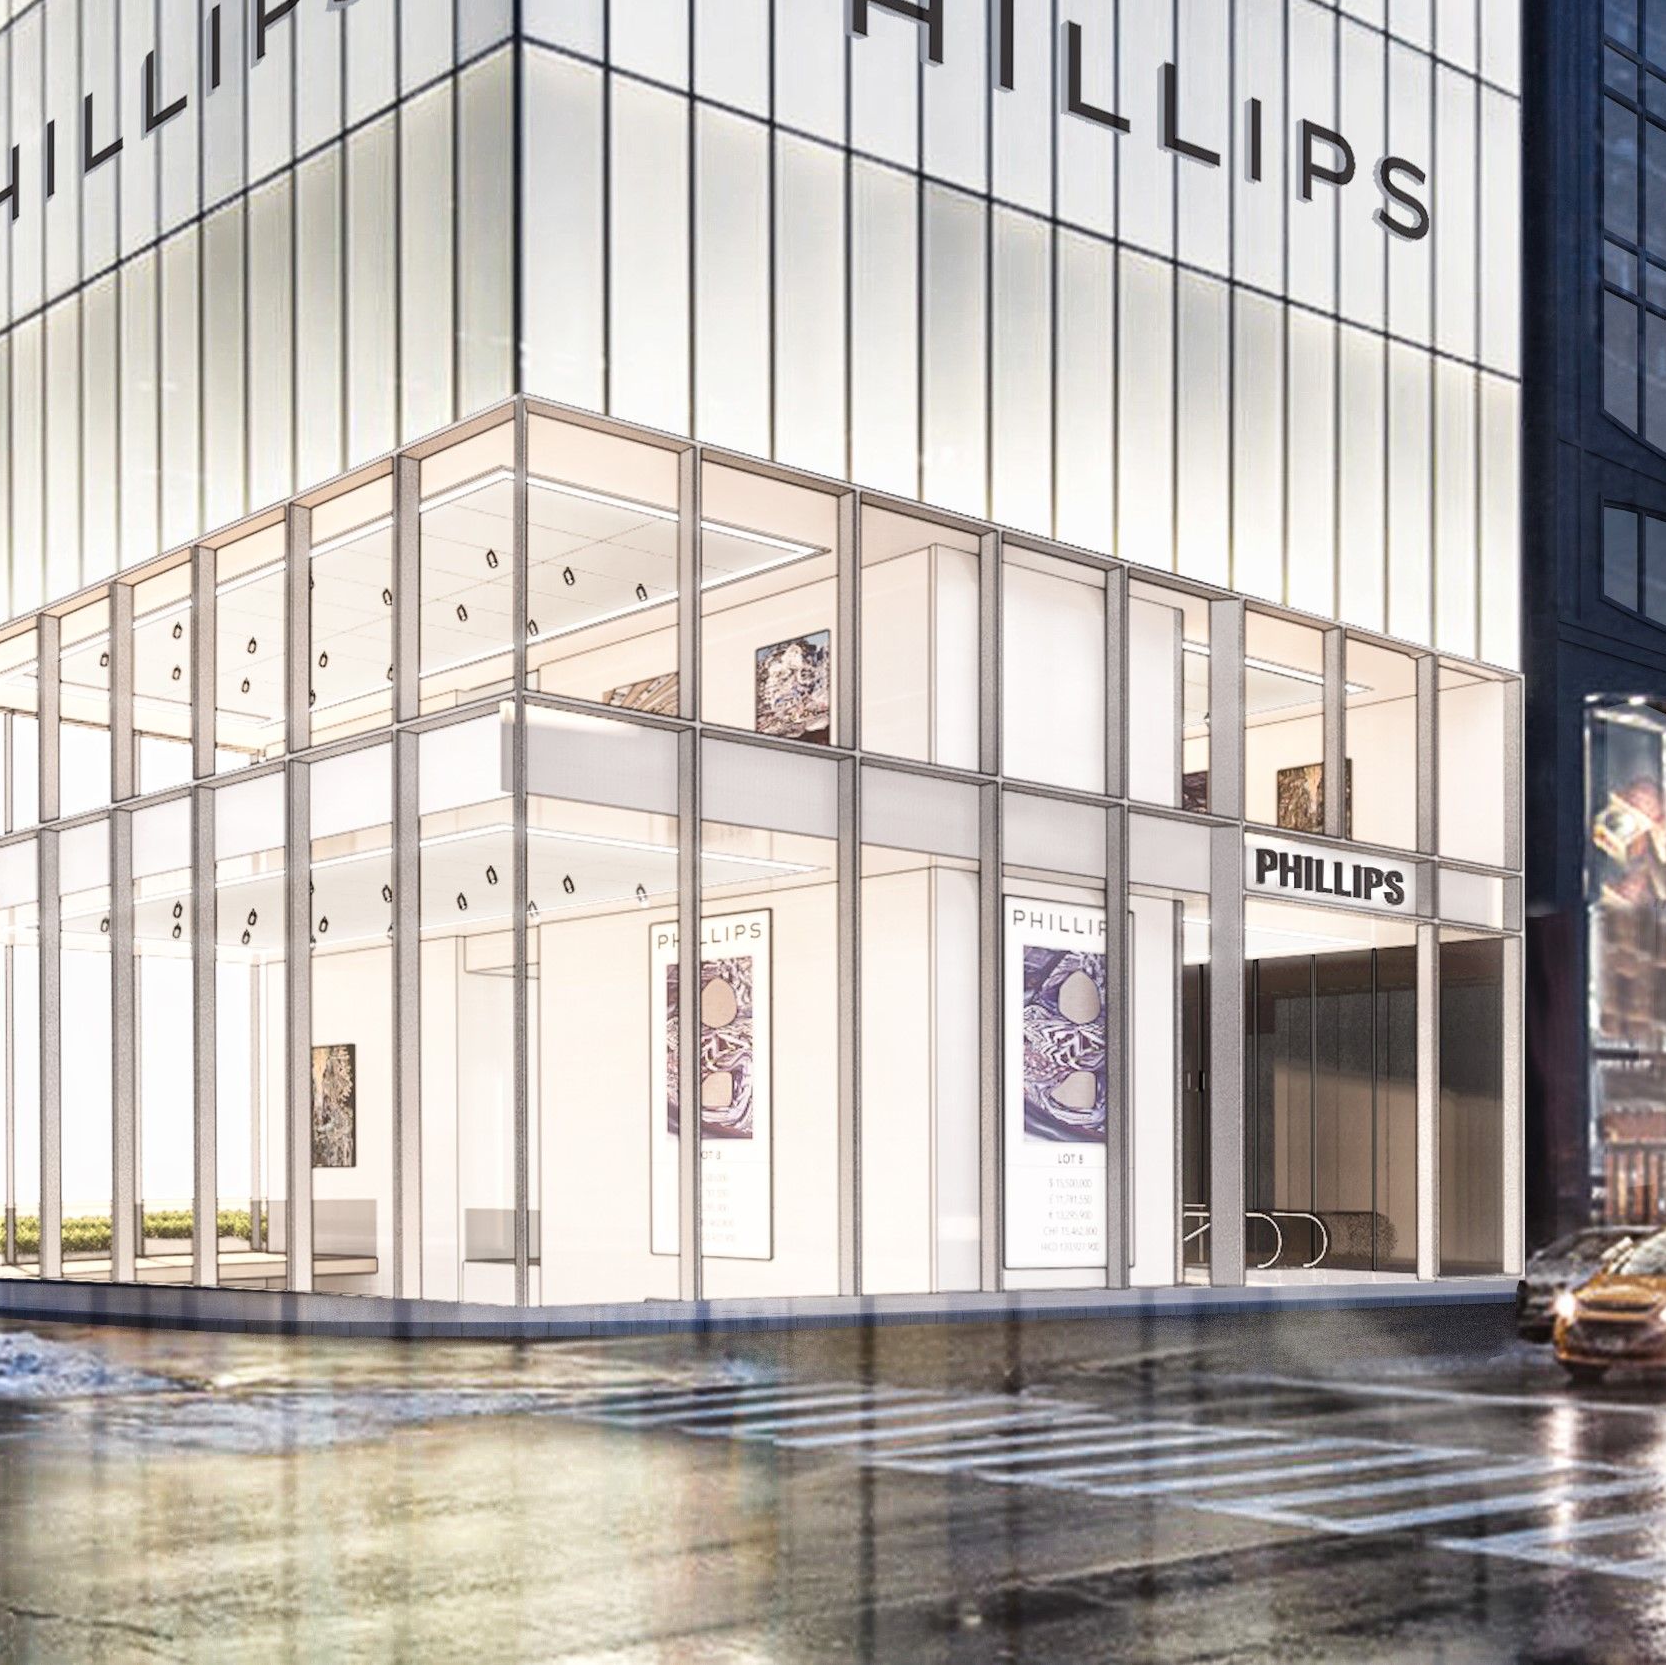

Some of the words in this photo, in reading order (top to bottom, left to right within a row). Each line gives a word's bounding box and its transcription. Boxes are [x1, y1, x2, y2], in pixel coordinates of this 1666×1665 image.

[1255, 848, 1405, 905] PHILLIPS
[1013, 909, 1106, 936] PHILLIP
[657, 923, 762, 949] PHLIPS
[1057, 1153, 1075, 1164] LOT
